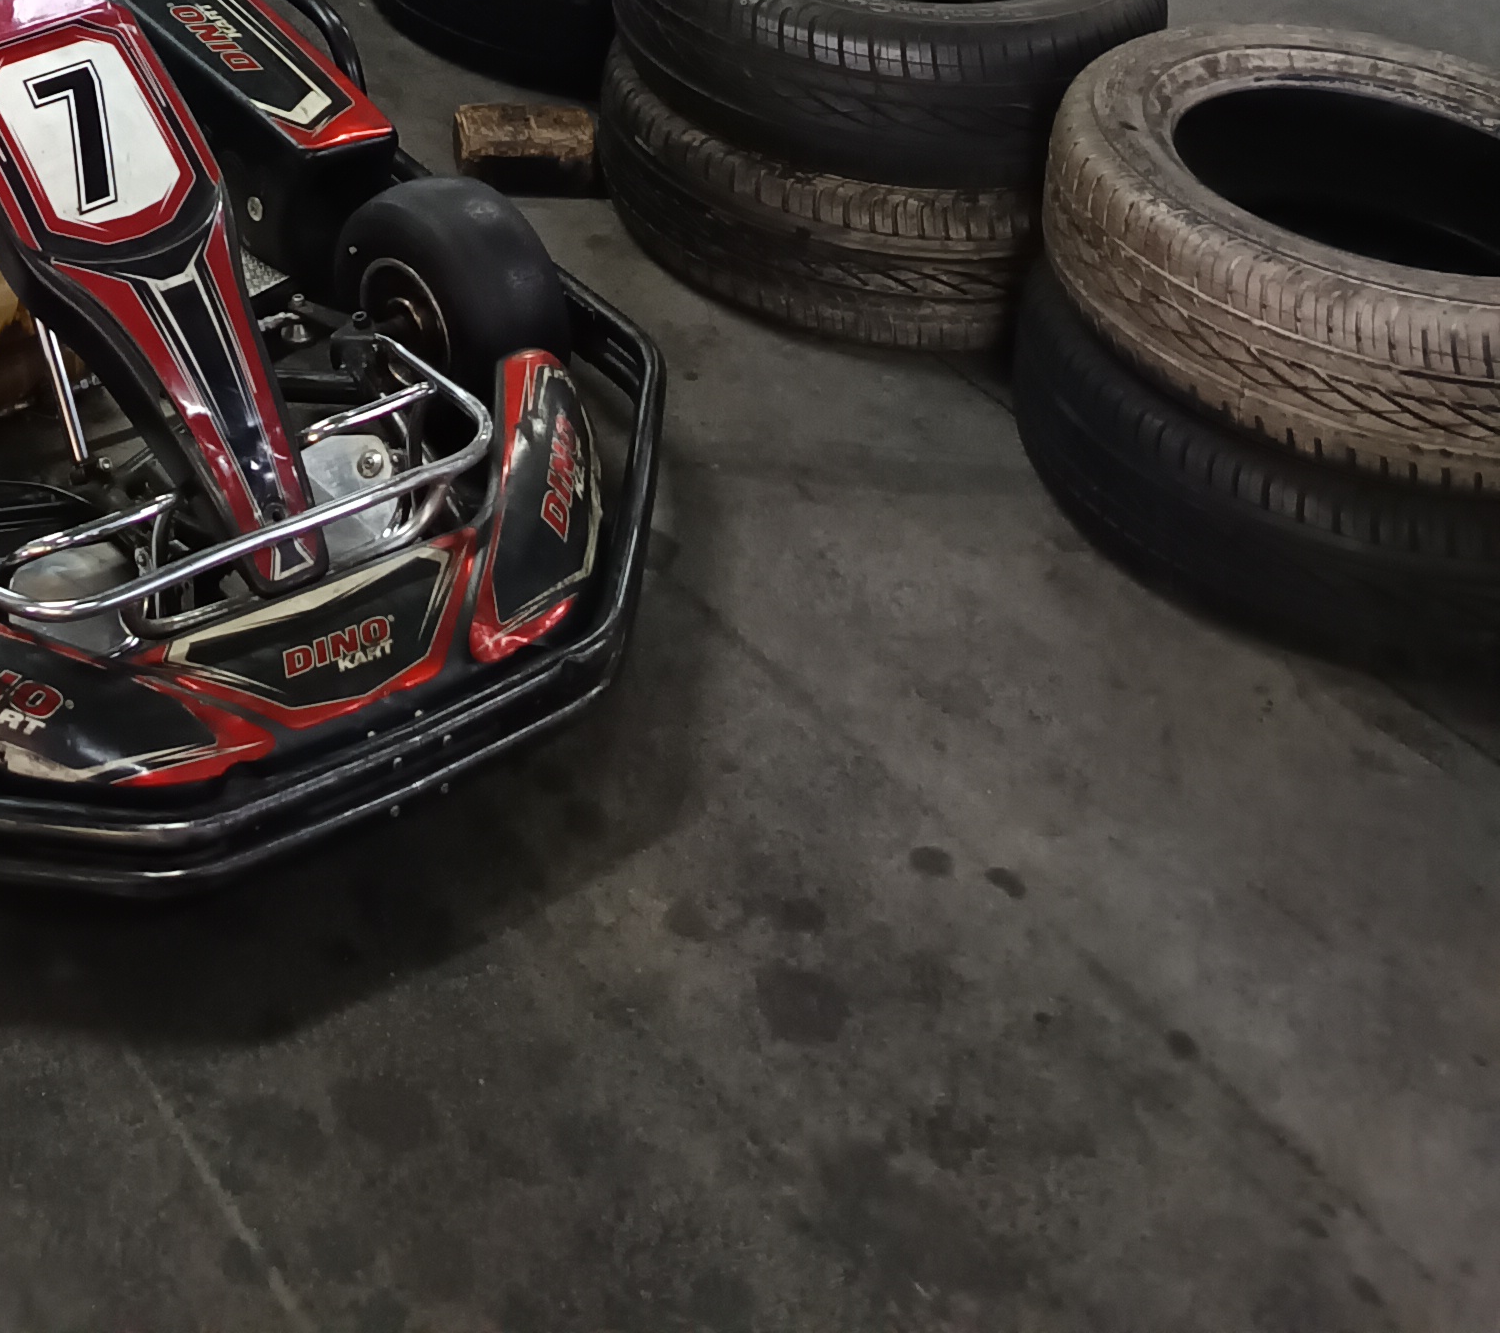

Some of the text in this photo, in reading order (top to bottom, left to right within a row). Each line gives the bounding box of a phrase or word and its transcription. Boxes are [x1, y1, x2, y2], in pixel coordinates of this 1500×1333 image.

[170, 4, 264, 72] DINO
[23, 59, 118, 216] 7
[283, 616, 390, 679] DINO
[338, 639, 394, 673] KART
